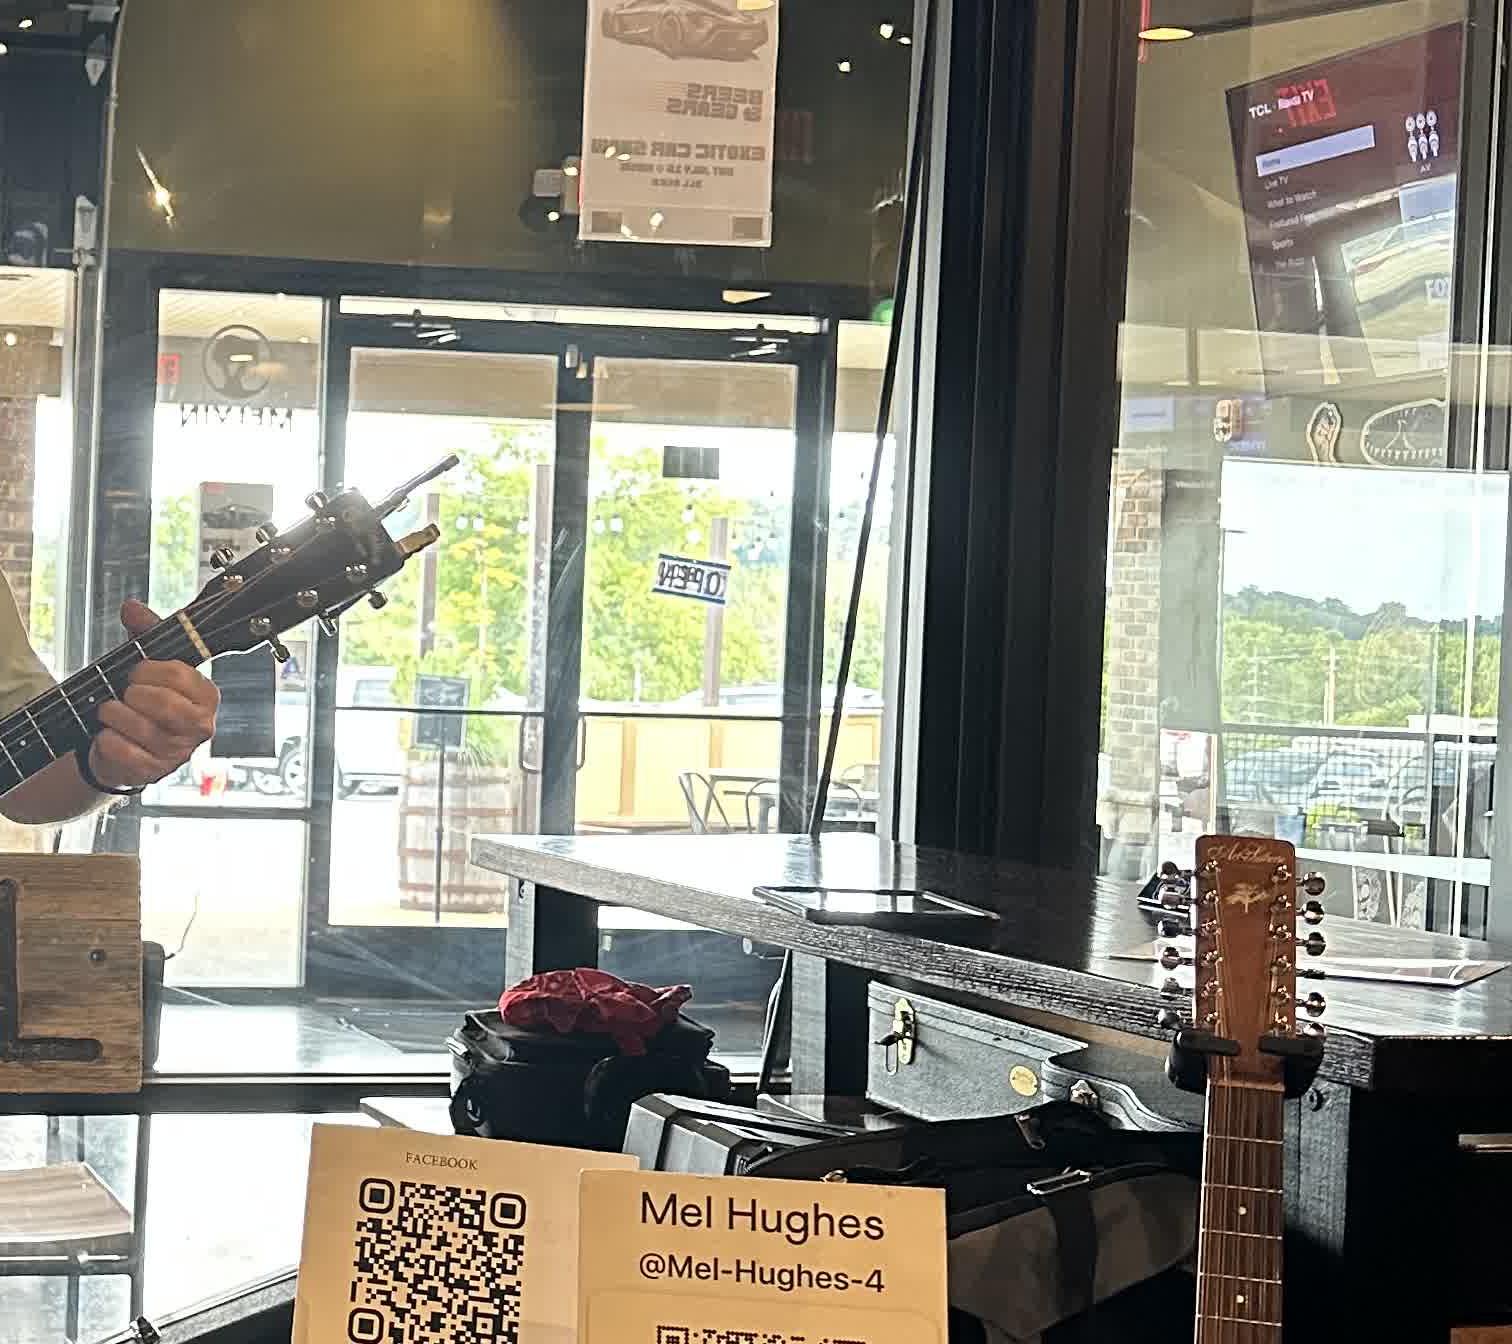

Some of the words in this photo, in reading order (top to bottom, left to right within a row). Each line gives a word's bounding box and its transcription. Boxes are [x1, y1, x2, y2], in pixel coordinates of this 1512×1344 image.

[1249, 104, 1273, 121] TCL
[1301, 89, 1315, 104] TV
[405, 1149, 479, 1172] FACEBOOK
[640, 1190, 713, 1232] Mel
[728, 1197, 886, 1245] Hughes
[639, 1252, 886, 1294] @Mel-Hughes-4
